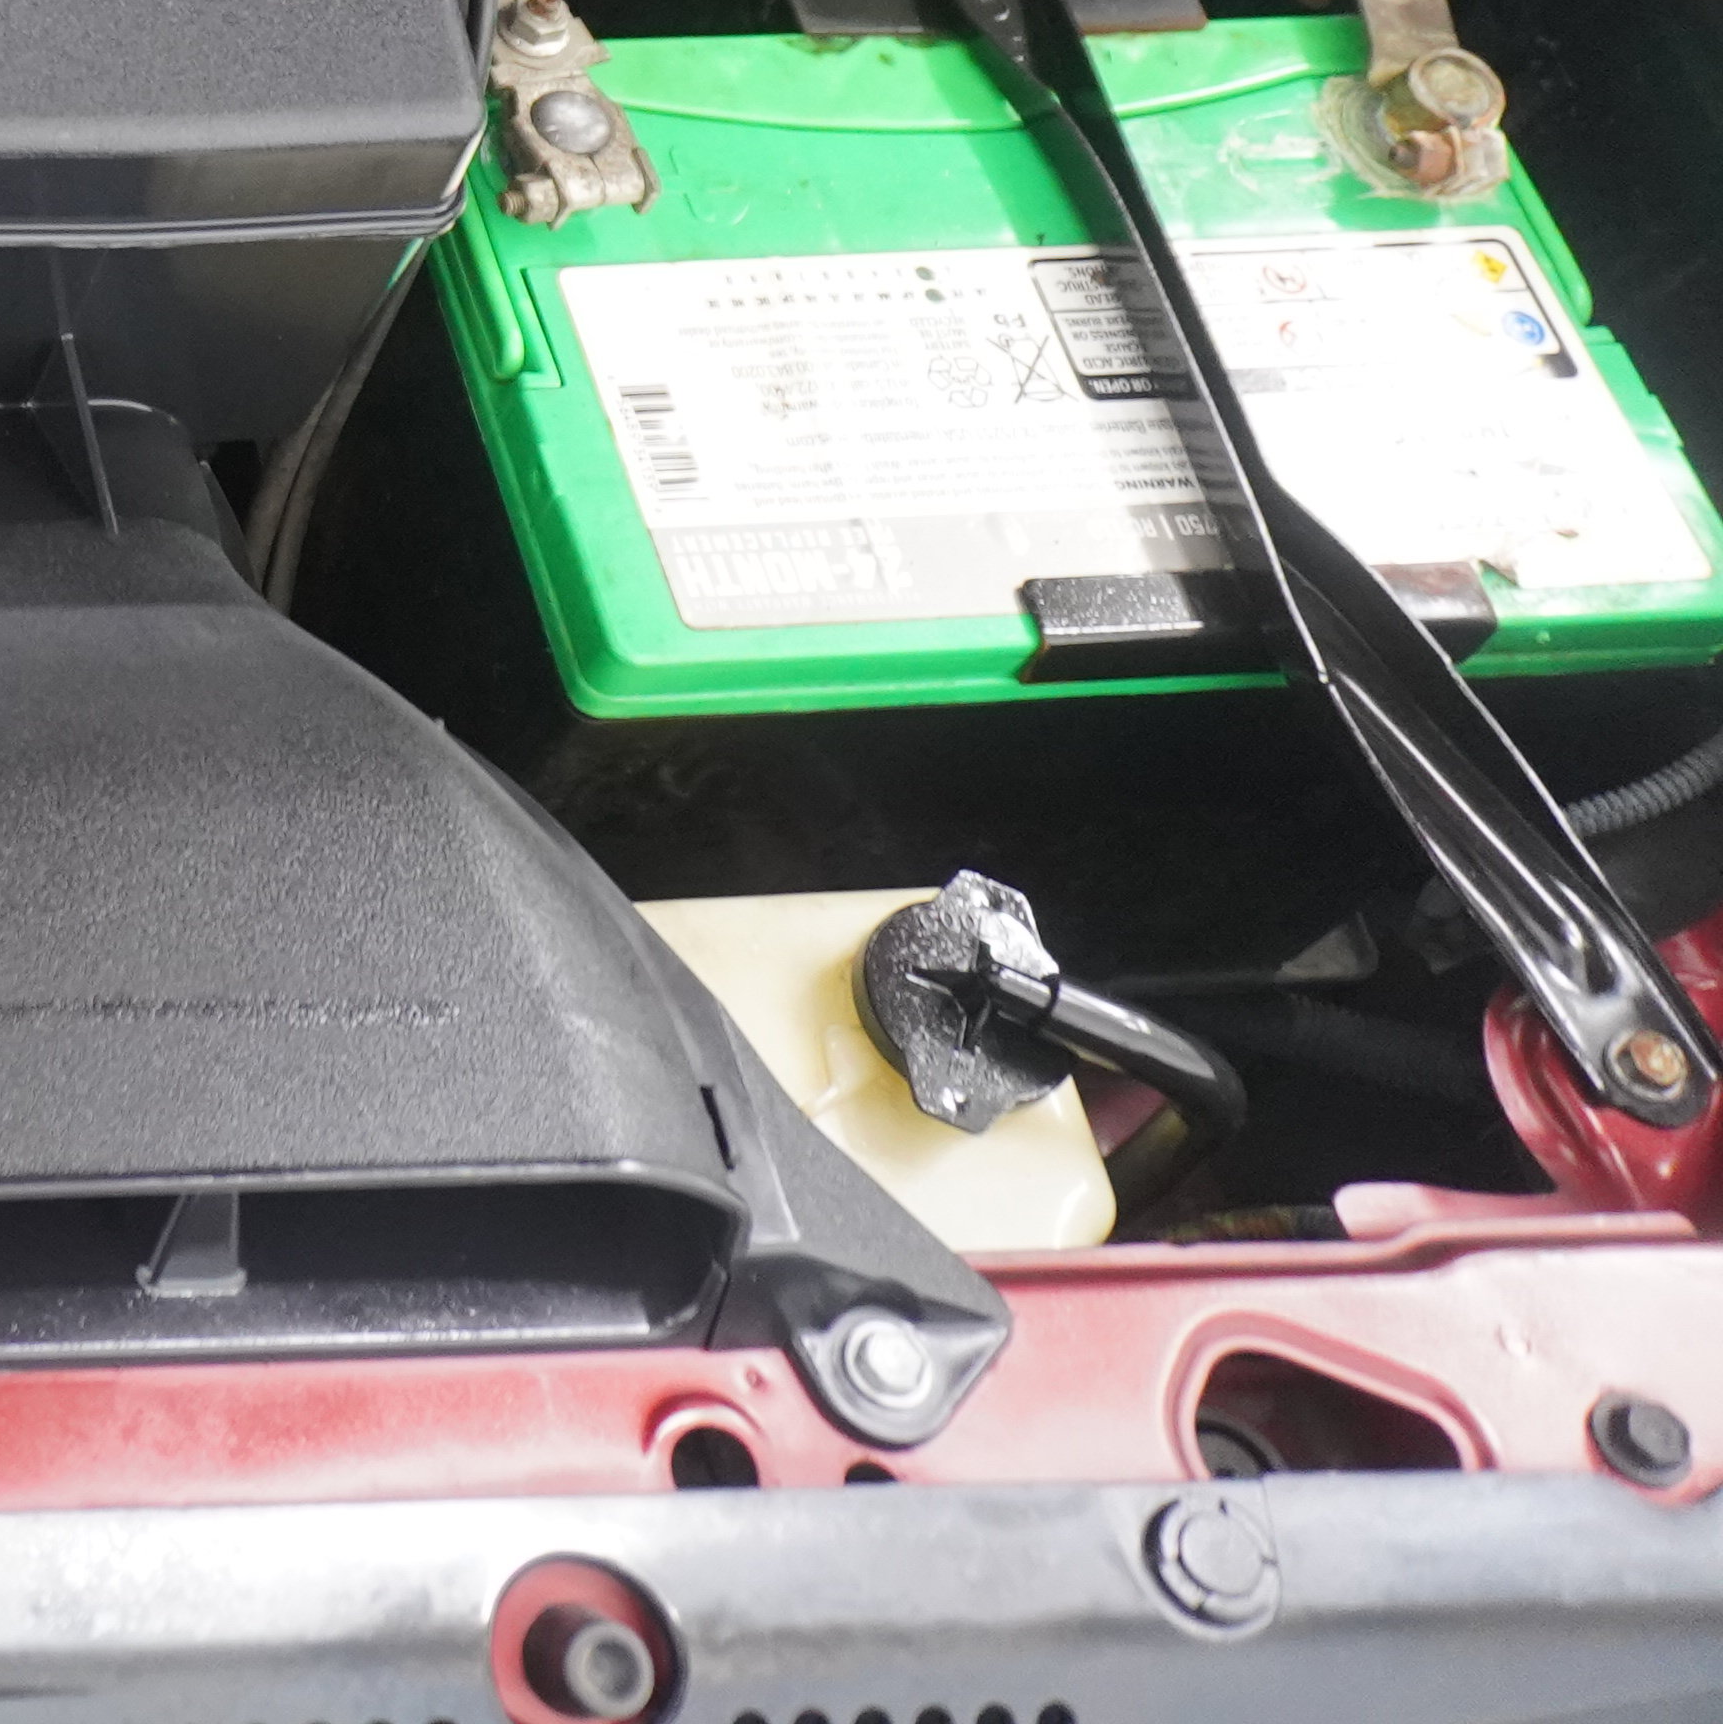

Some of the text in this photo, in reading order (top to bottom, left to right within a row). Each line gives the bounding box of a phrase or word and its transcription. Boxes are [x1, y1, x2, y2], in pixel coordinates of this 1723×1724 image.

[1082, 357, 1113, 369] ACID
[1130, 378, 1151, 393] OR
[673, 528, 833, 554] REPLACEMENT
[675, 546, 914, 597] 24-MONTH
